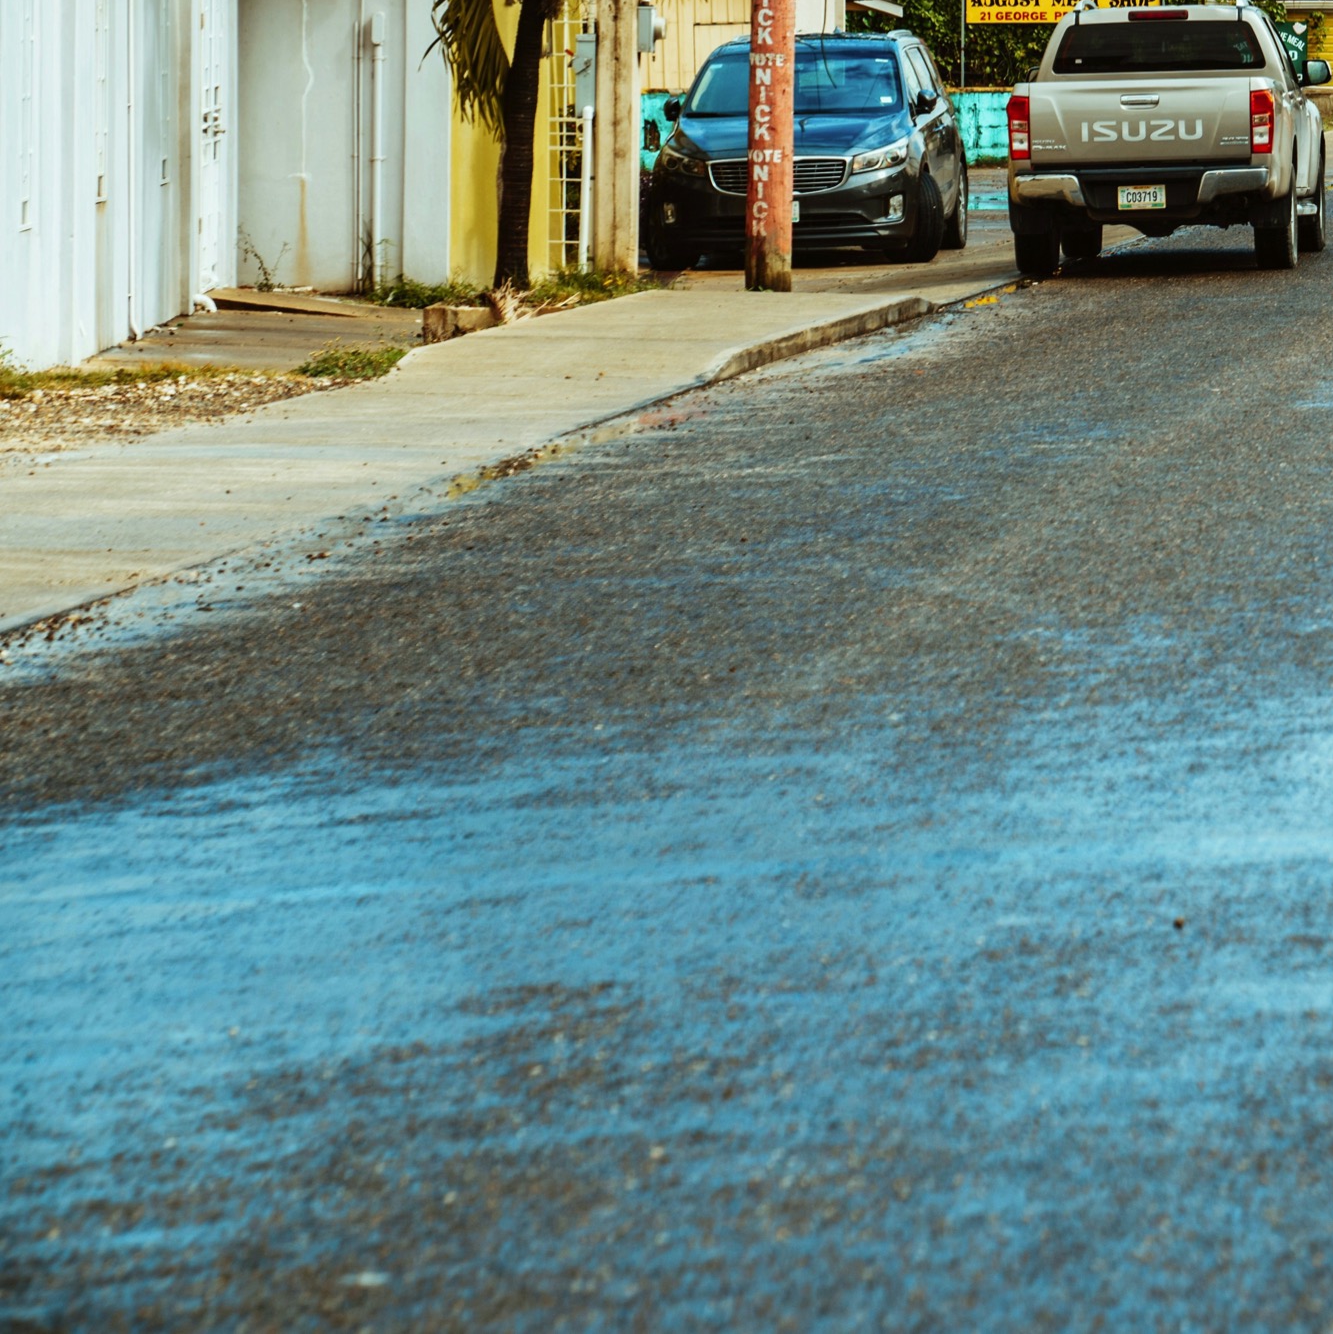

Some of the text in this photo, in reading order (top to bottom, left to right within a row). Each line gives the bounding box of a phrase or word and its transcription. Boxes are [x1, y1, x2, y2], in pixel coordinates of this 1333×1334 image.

[980, 12, 991, 21] 21
[996, 12, 1048, 21] GEORGE
[1286, 33, 1306, 52] MEAL
[755, 68, 771, 141] NICK
[1081, 119, 1203, 142] ISUZU
[752, 165, 768, 237] NICK
[1126, 191, 1158, 204] C03719
